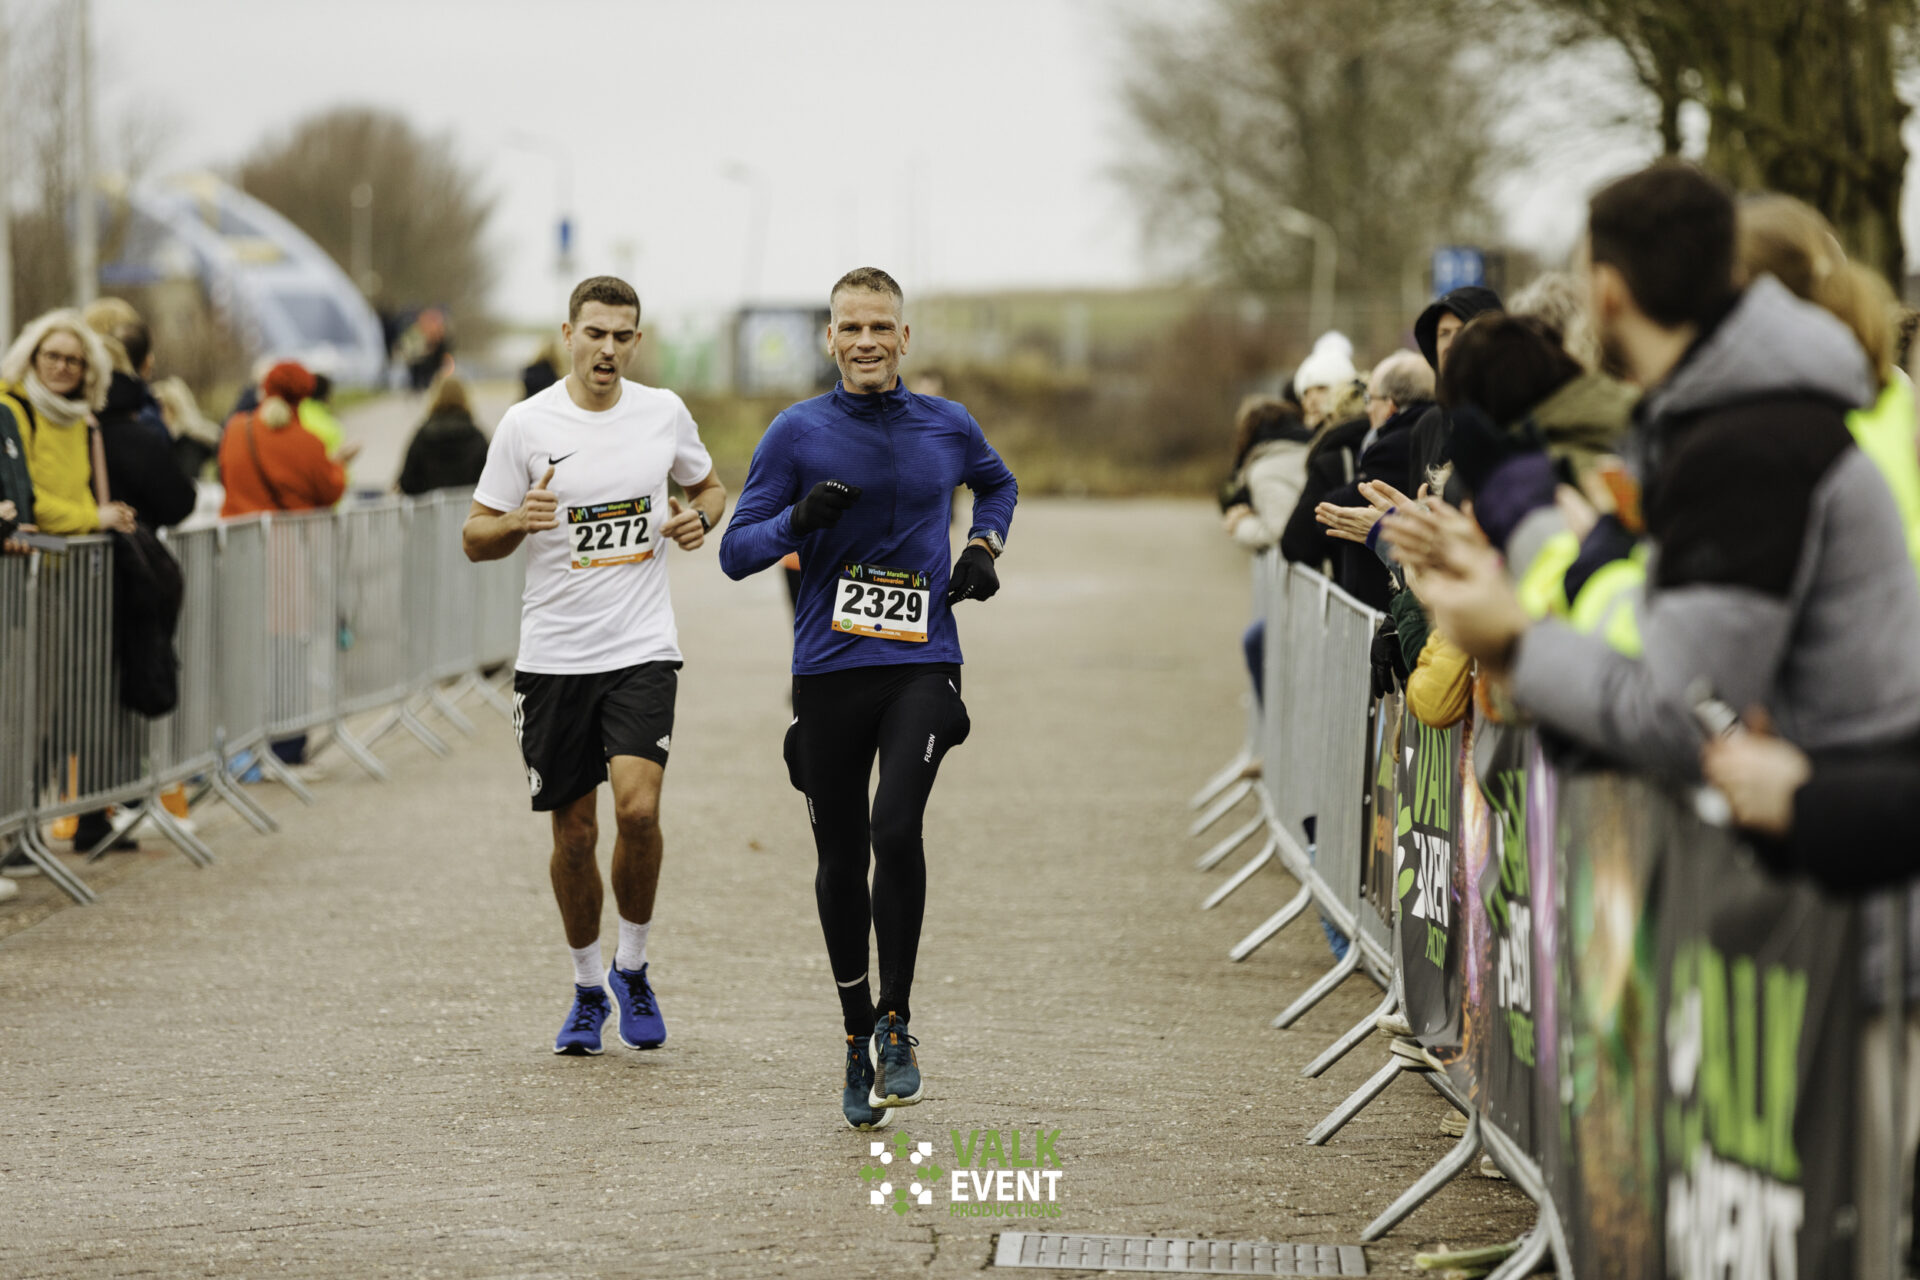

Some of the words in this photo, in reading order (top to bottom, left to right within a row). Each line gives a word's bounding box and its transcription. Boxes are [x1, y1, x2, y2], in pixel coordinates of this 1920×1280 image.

[576, 517, 649, 552] 2272
[868, 567, 886, 576] Winter
[886, 570, 910, 578] Marathon
[841, 583, 922, 623] 2329
[923, 733, 936, 763] FUSION
